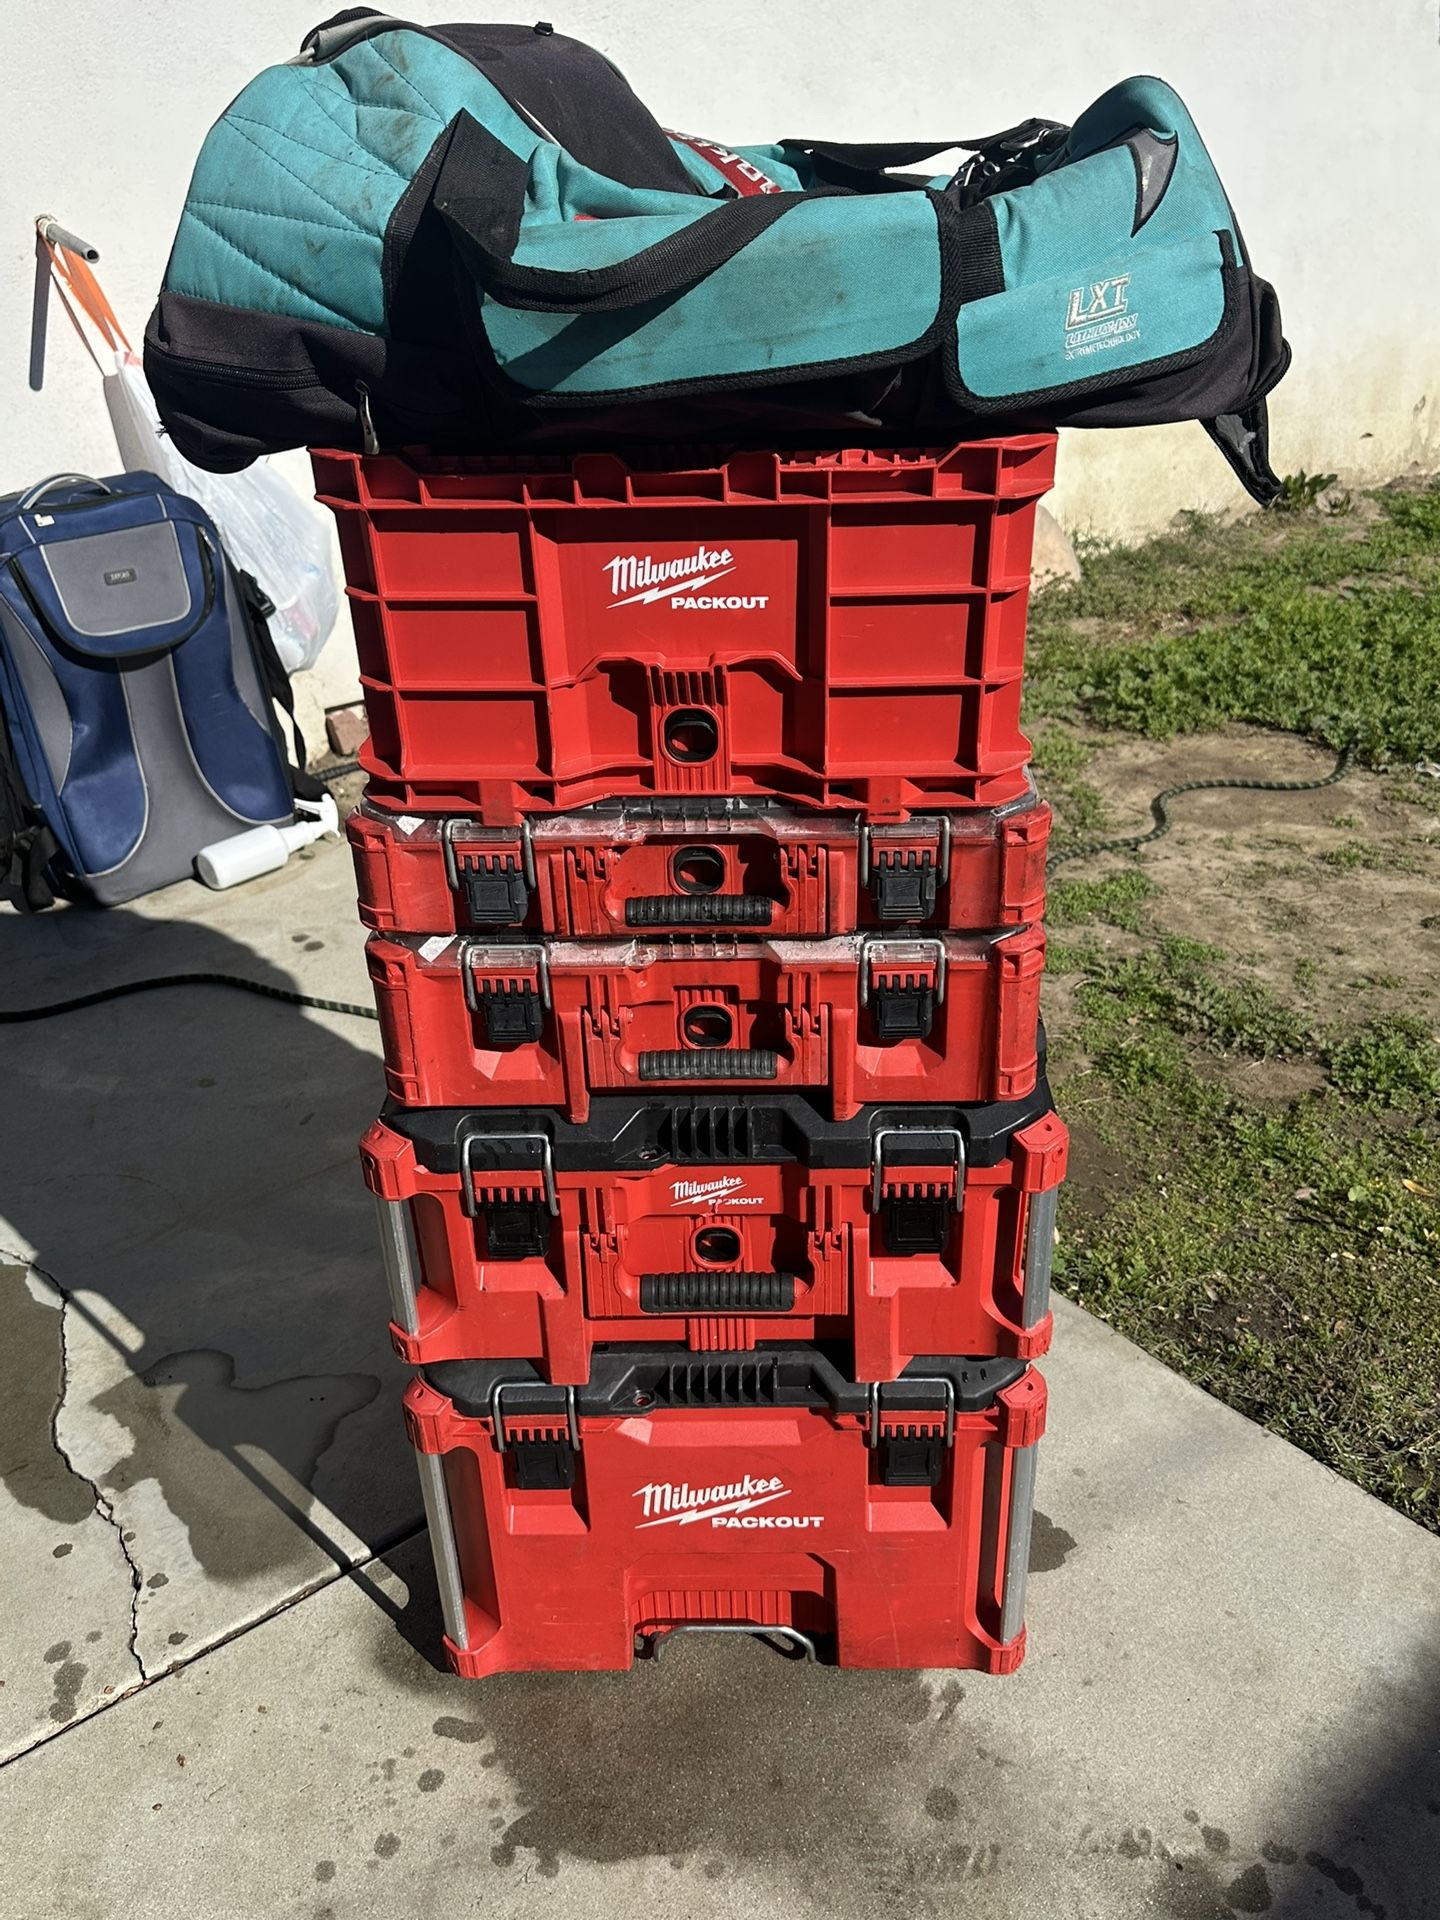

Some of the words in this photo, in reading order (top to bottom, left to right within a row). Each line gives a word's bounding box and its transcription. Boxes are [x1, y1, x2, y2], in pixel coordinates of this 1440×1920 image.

[1065, 271, 1131, 331] LXT
[602, 545, 734, 596] Milwaukee
[671, 596, 769, 610] PACKOUT
[669, 1175, 743, 1200] Milwaukee
[632, 1474, 784, 1517] Milwaukee
[711, 1516, 825, 1529] PACKOUT
